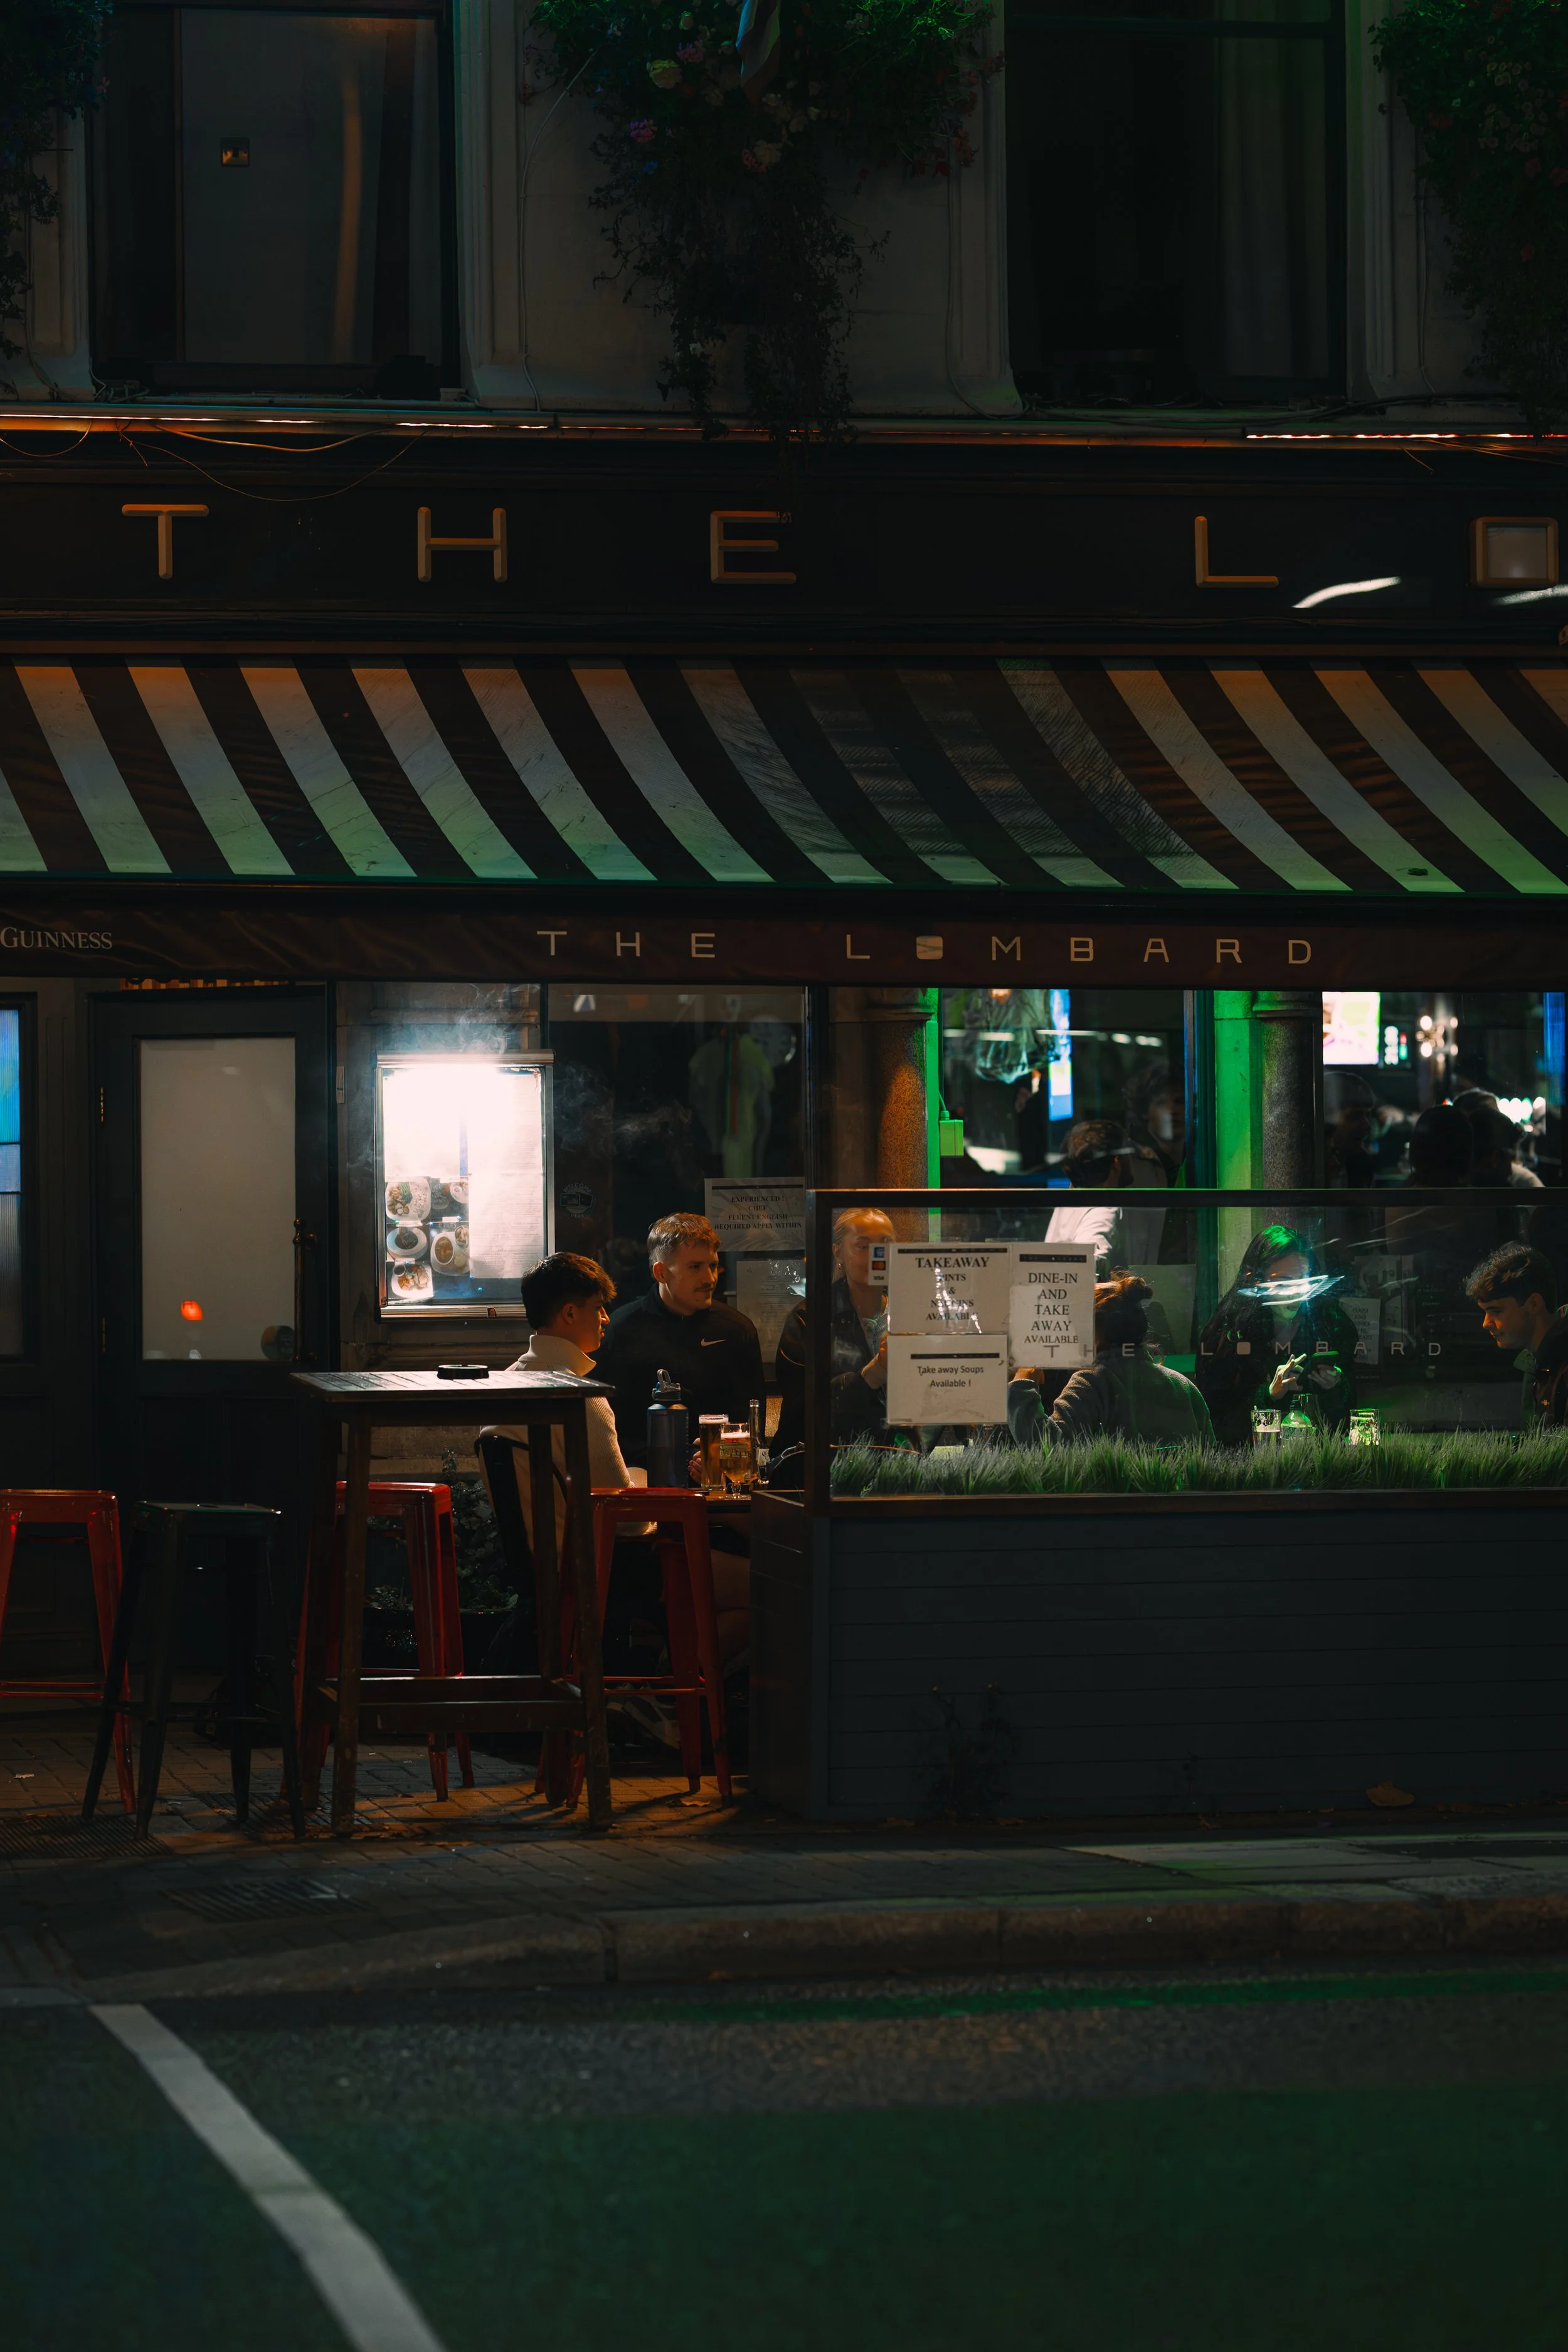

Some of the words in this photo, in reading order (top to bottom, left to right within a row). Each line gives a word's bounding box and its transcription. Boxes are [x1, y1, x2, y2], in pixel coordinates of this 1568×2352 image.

[122, 504, 797, 584] THE
[0, 926, 114, 950] GUINNESS
[536, 930, 716, 959] THE
[915, 1256, 990, 1268] TAKEAWAY
[1028, 1272, 1078, 1284] DINE-IN
[948, 1286, 956, 1295] &
[1039, 1289, 1067, 1300] AND
[1034, 1305, 1070, 1315] TAKE
[925, 1313, 978, 1321] AVAILABL
[1030, 1320, 1073, 1331] AWAY
[1024, 1335, 1079, 1343] AVAILABLE
[960, 1365, 984, 1375] Soups
[930, 1379, 967, 1387] Available
